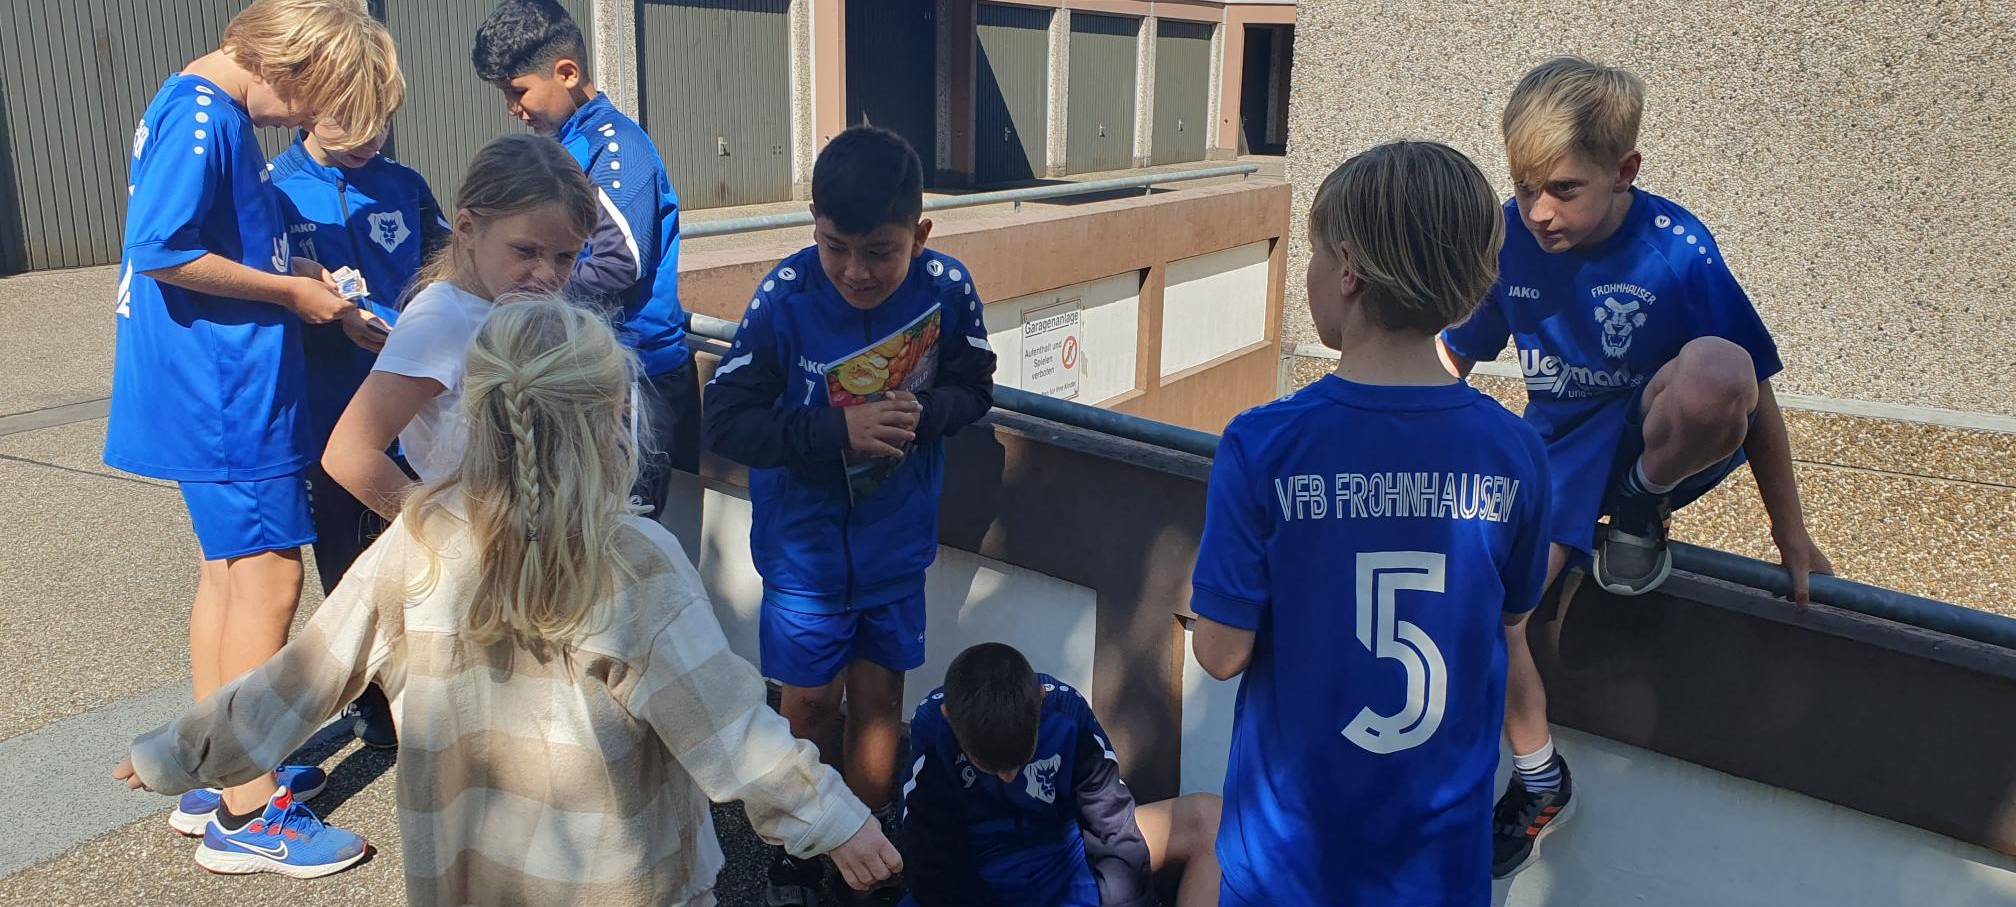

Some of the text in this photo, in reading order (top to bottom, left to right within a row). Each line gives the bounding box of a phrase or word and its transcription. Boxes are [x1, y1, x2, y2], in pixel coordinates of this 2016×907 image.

[289, 223, 317, 233] JAKO
[1508, 286, 1540, 299] JAKO
[1591, 283, 1657, 305] FROHNHAUSER
[1024, 311, 1079, 335] Garagenanlage
[1025, 343, 1051, 358] Aufenthalt
[1031, 367, 1055, 380] verboten
[1033, 356, 1053, 369] Spielen
[804, 378, 816, 406] 7
[1275, 472, 1520, 522] VFB FROHNHAUSEN
[1340, 551, 1448, 754] 5
[962, 766, 977, 788] 9
